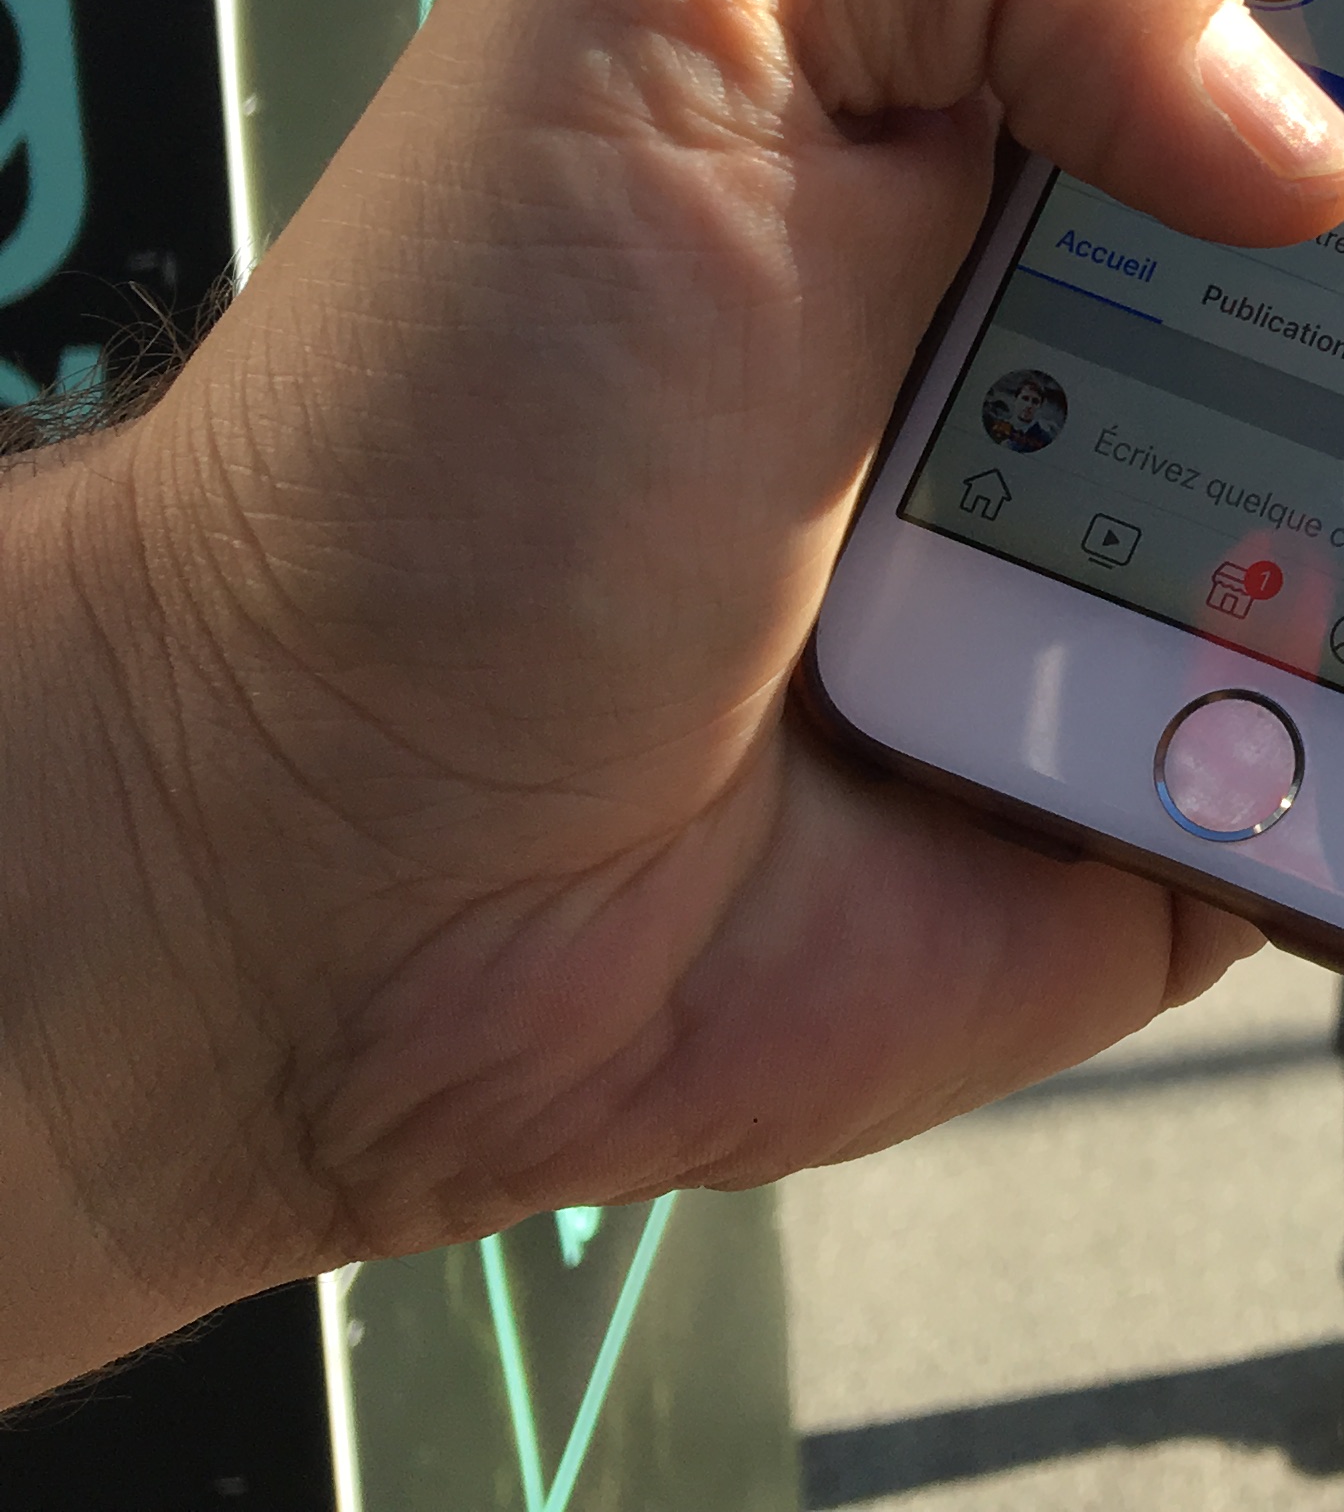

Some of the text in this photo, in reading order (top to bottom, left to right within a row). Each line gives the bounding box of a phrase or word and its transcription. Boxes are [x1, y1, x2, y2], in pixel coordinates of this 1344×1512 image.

[1056, 230, 1158, 283] Accueil
[1094, 424, 1202, 490] Écrivez
[1206, 478, 1323, 538] quelque
[1259, 570, 1273, 592] 1
